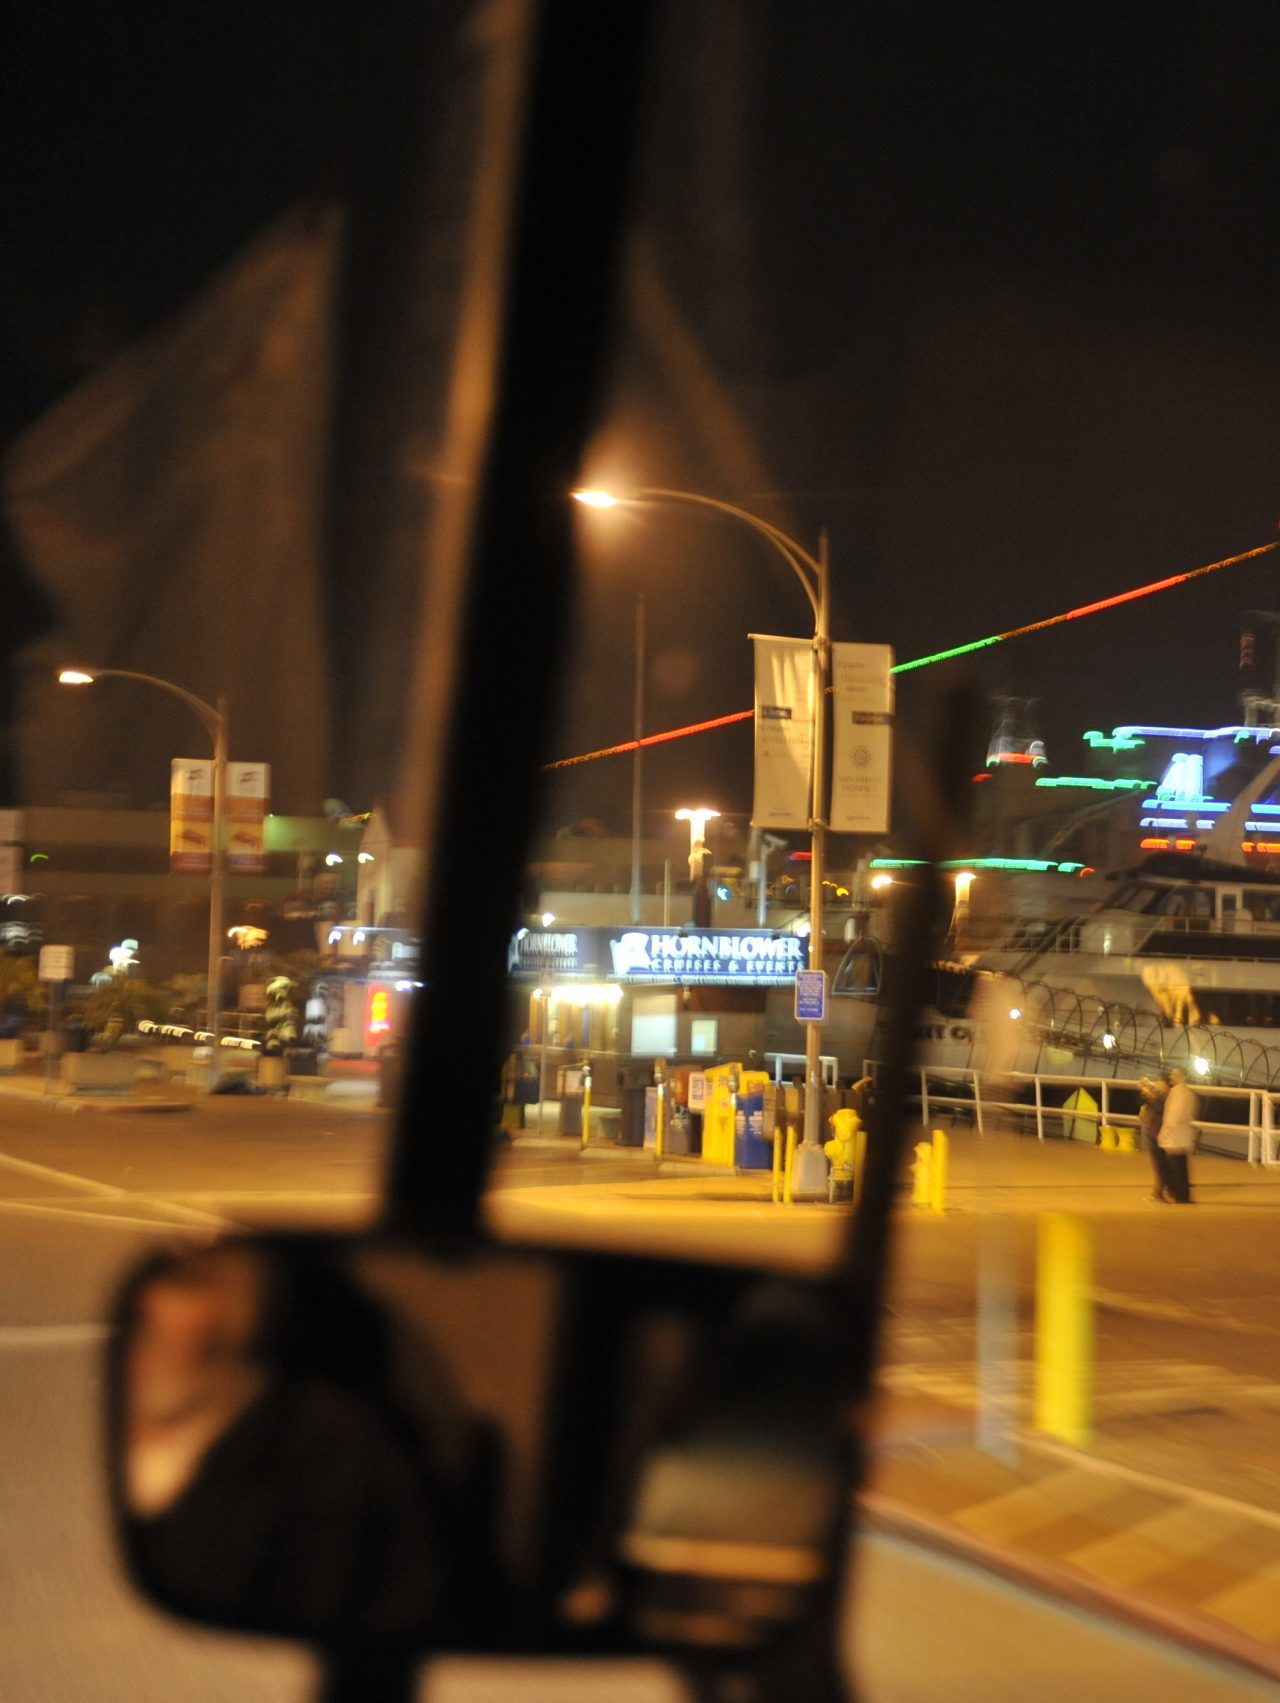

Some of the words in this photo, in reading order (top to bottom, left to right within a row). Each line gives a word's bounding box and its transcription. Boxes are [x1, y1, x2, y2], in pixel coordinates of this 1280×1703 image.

[650, 934, 804, 960] HORNBLOWER
[650, 959, 721, 973] CRUISES
[746, 960, 805, 975] EVENTS
